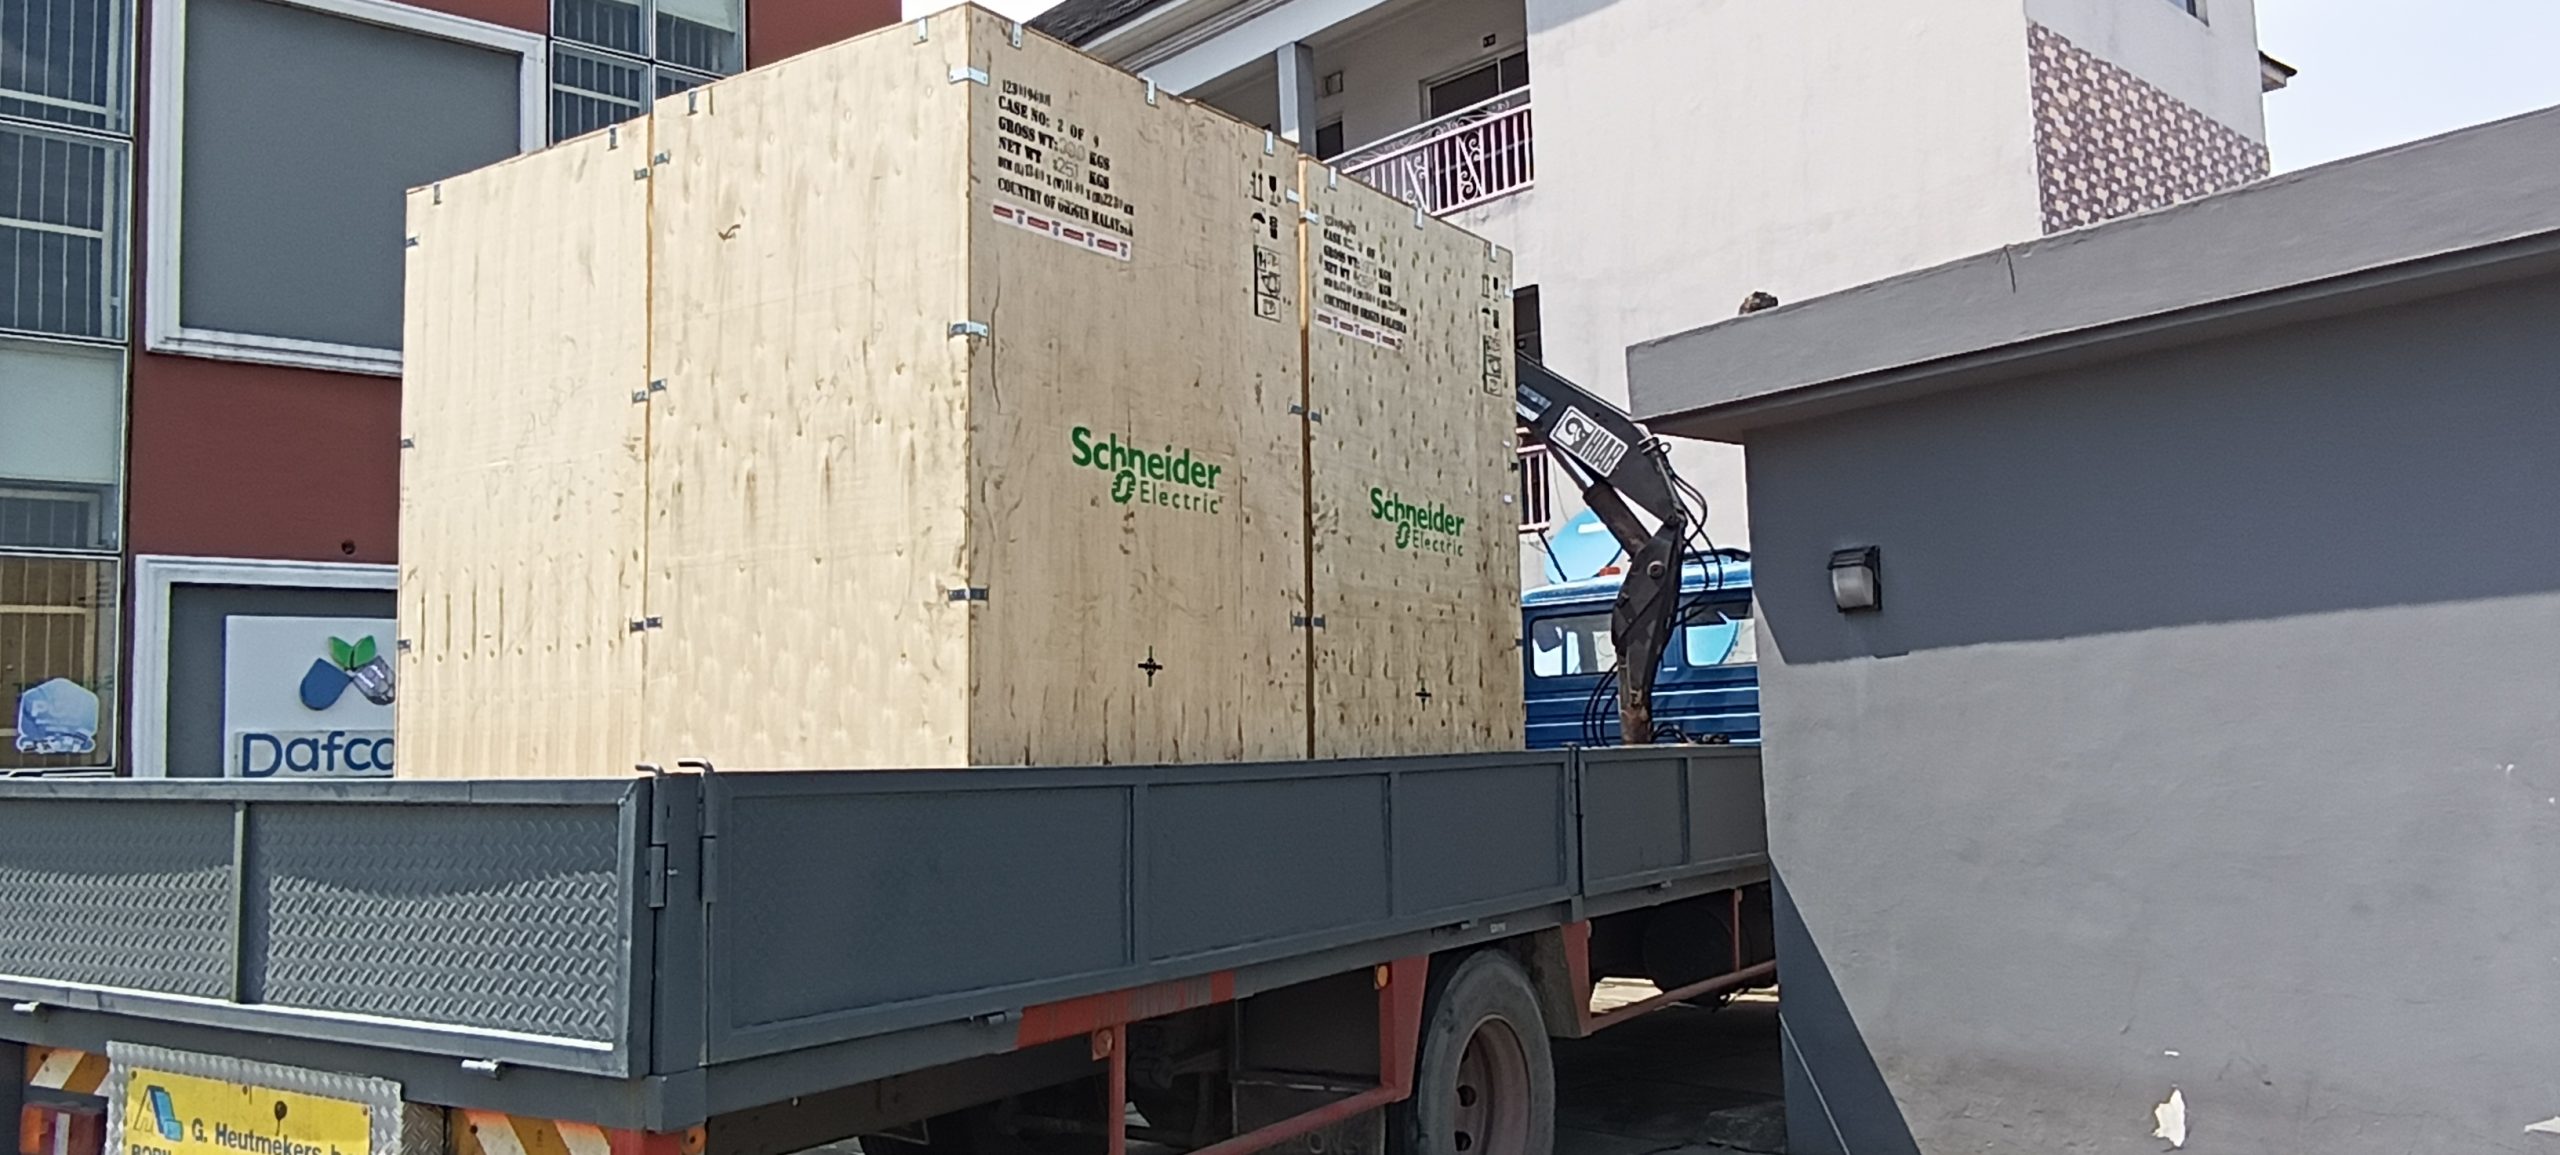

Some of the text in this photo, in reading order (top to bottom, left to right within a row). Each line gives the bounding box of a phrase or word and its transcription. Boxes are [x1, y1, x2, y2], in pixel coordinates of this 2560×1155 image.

[998, 95, 1028, 119] CASE
[1030, 107, 1050, 128] NO:
[1058, 118, 1064, 133] 2
[1070, 124, 1084, 140] OF
[998, 116, 1035, 141] GROSS
[1038, 131, 1058, 151] WT:
[1089, 151, 1110, 171] KGS
[998, 137, 1021, 156] NET
[1089, 170, 1109, 189] KGS
[998, 177, 1042, 205] COUNTRY
[1044, 194, 1056, 209] OF
[1071, 426, 1221, 490] Schneider
[1581, 429, 1625, 475] HIAB
[1140, 480, 1219, 515] Electric
[1370, 487, 1465, 538] Schneider
[1412, 529, 1464, 557] Electric
[192, 1118, 208, 1143] G.
[215, 1121, 322, 1155] Heutmekers
